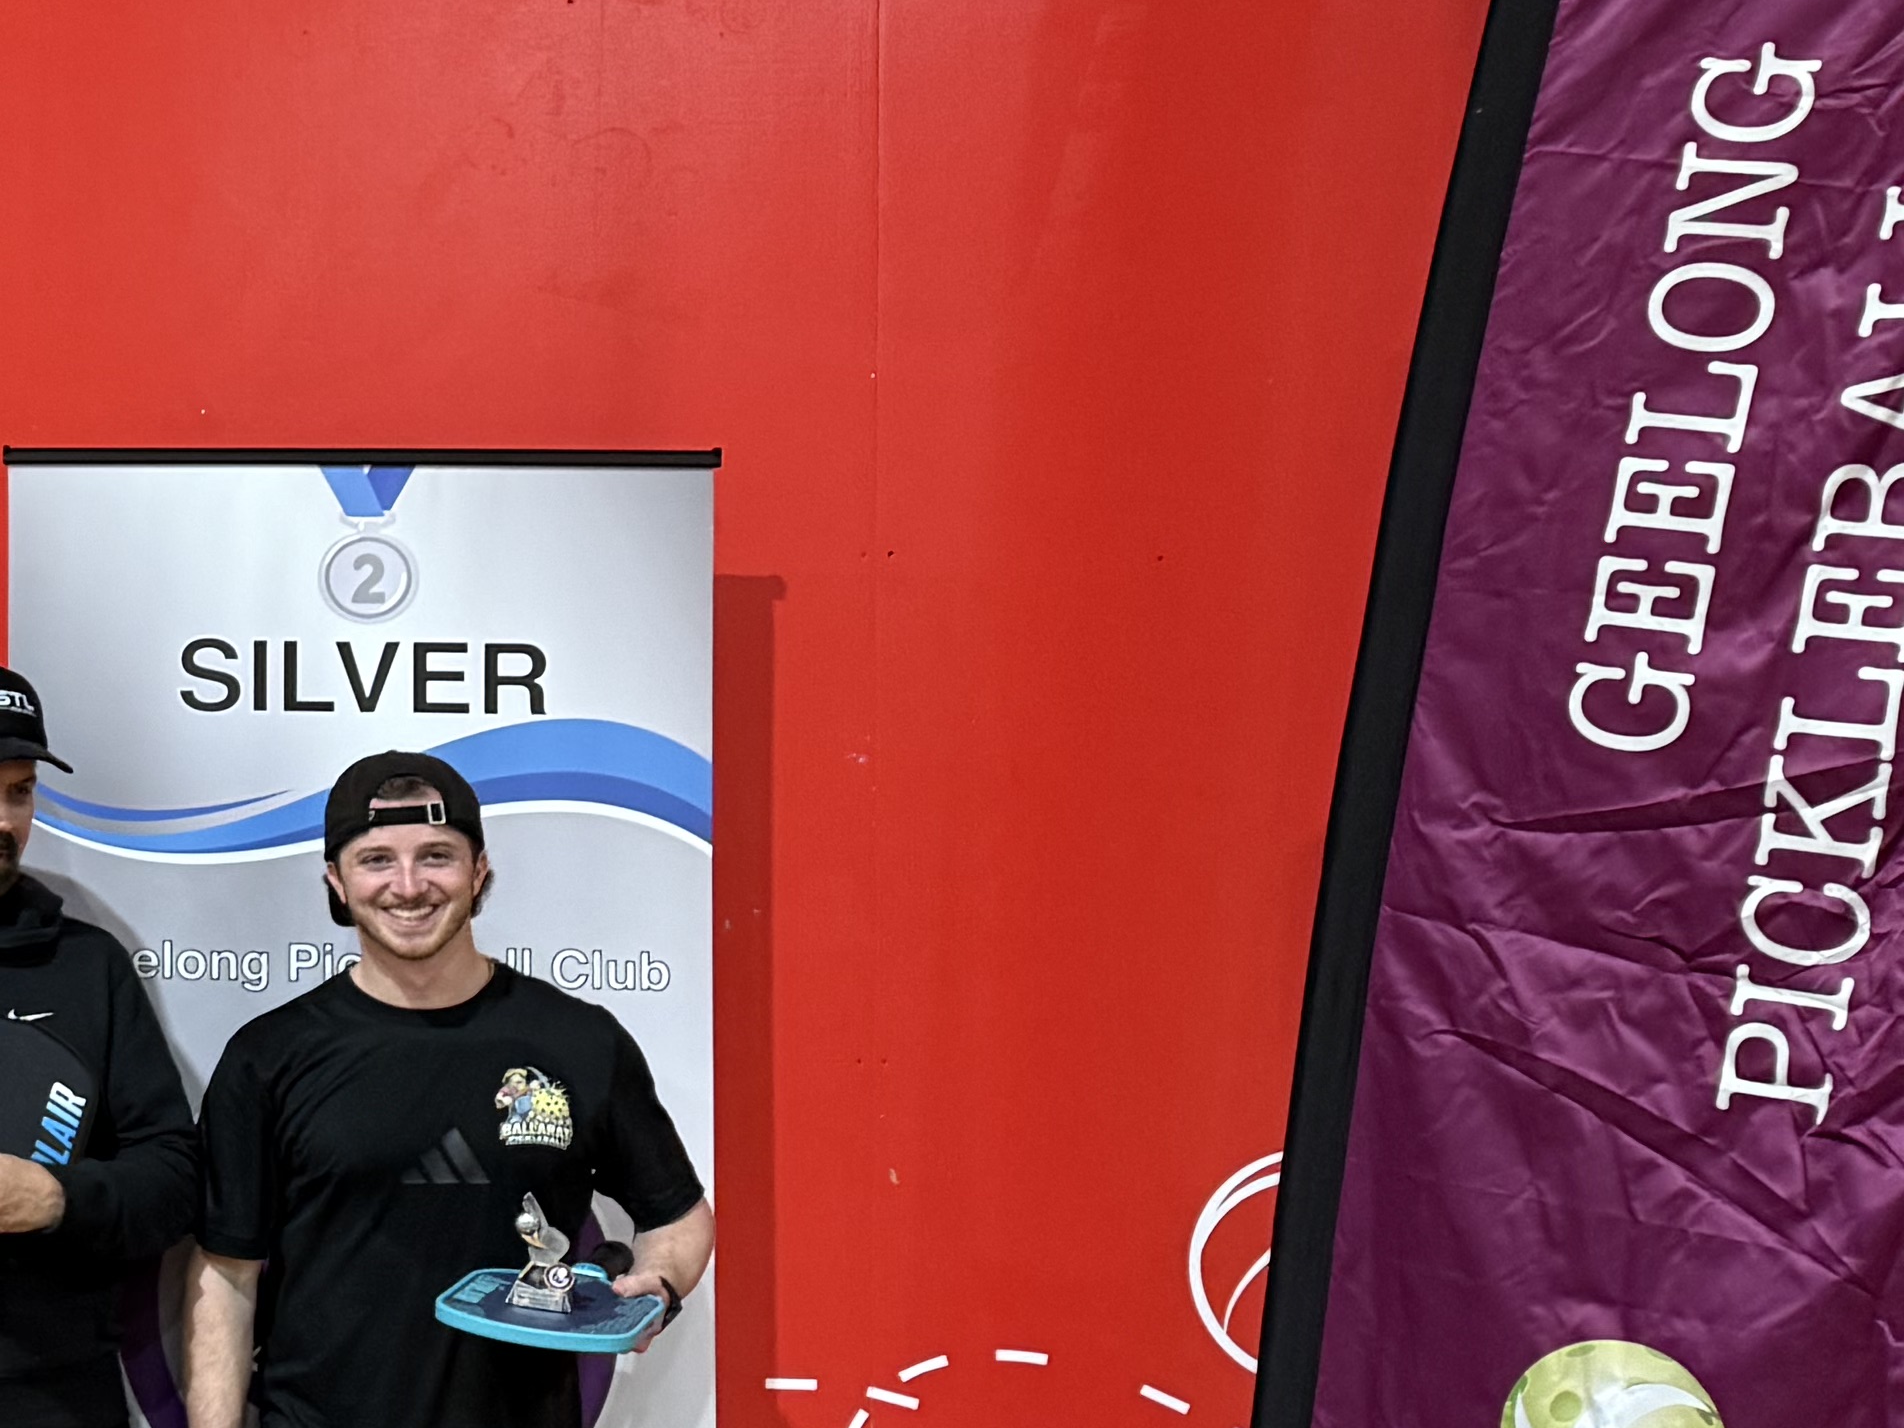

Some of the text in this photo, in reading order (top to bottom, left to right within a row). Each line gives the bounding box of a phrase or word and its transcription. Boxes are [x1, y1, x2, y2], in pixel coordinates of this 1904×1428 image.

[1568, 41, 1823, 752] GEELONG
[351, 553, 386, 605] 2
[179, 637, 547, 716] SILVER
[1715, 186, 1904, 1126] PICKLEBA
[133, 939, 269, 992] elong
[551, 948, 670, 992] Club
